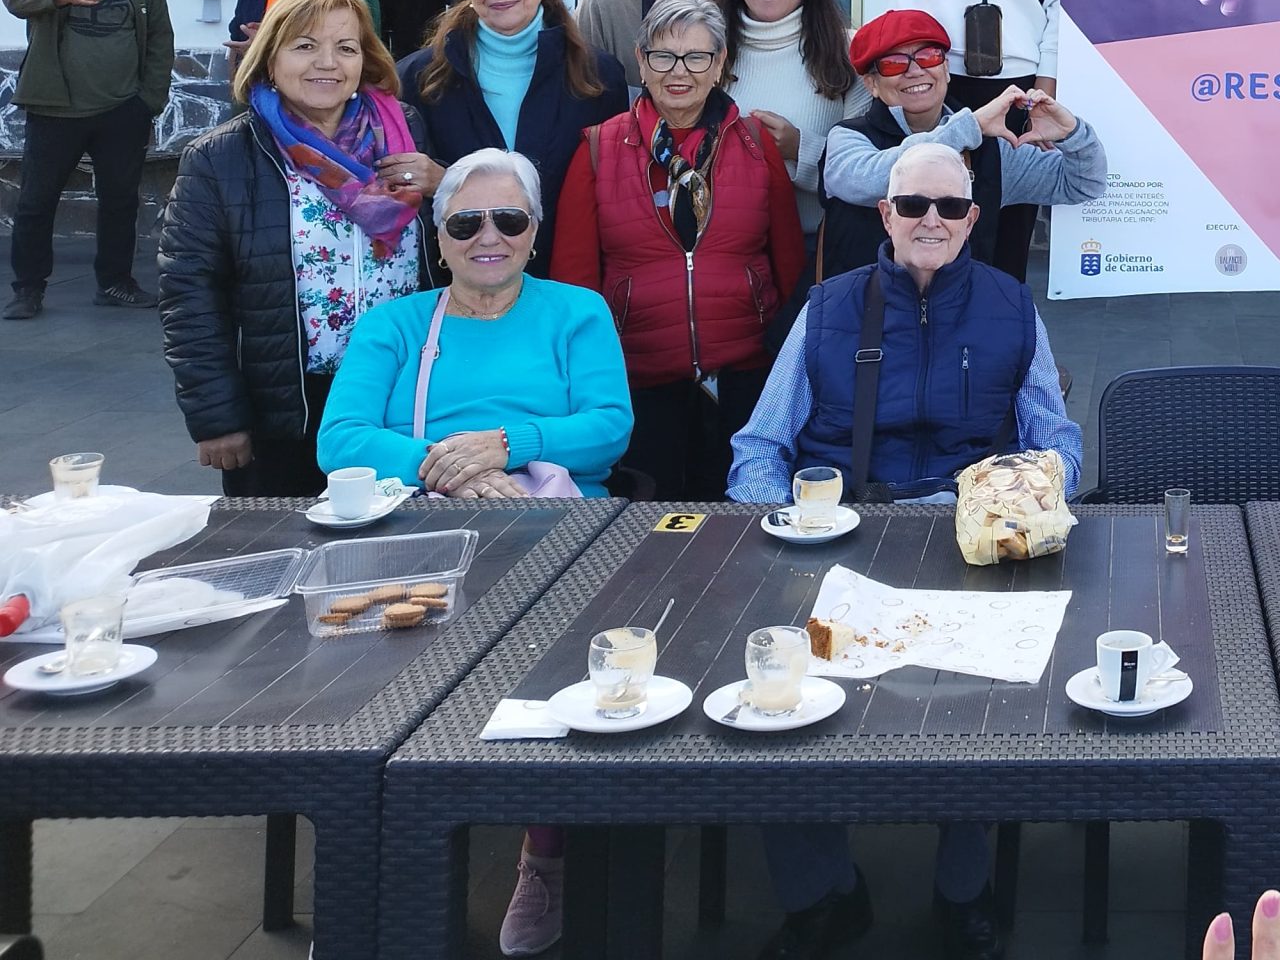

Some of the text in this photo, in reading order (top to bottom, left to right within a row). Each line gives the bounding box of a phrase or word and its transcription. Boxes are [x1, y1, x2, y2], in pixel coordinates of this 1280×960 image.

[1105, 253, 1153, 263] Gobierno
[1105, 263, 1164, 272] de Canarias
